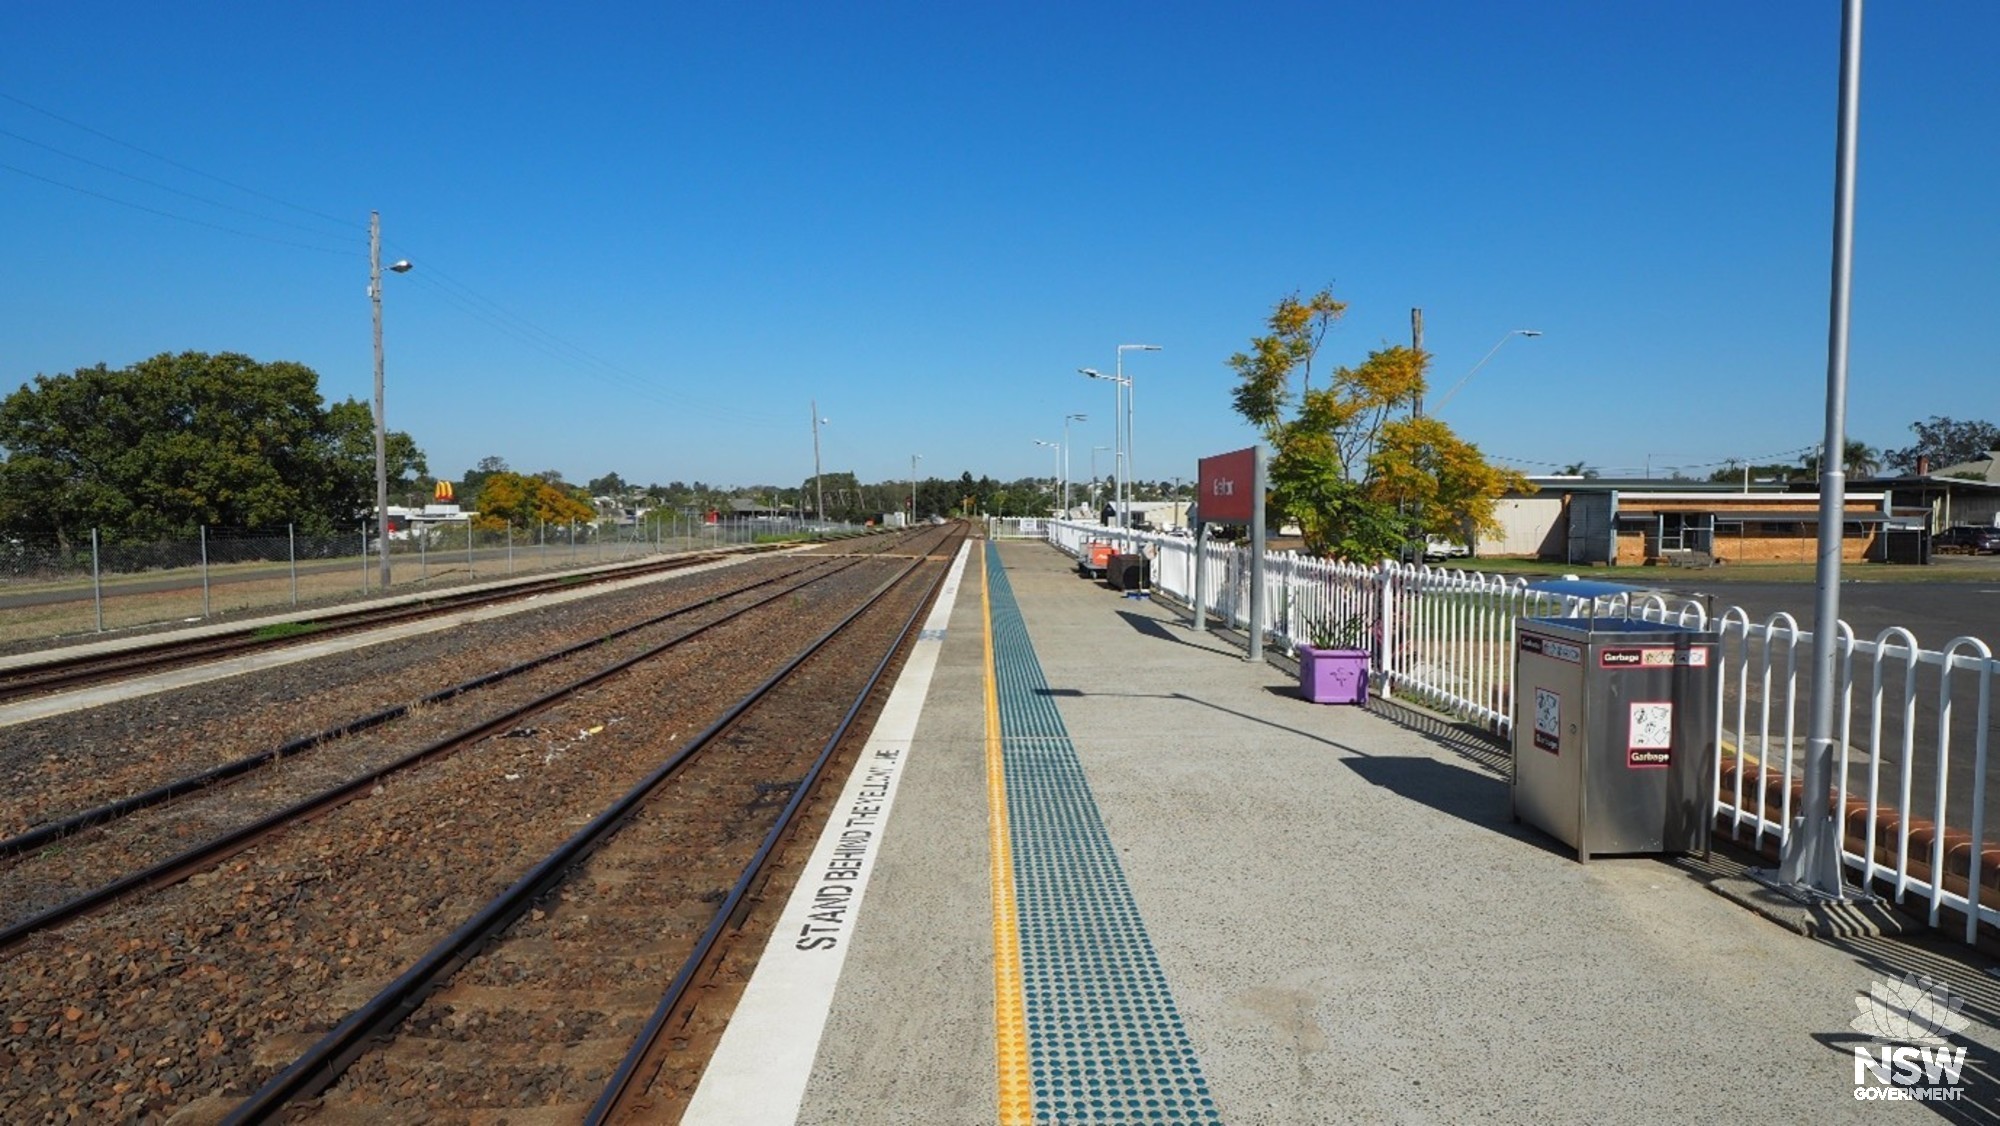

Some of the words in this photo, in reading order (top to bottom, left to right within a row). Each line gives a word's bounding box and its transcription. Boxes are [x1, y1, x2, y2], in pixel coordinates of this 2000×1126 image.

[1604, 653, 1640, 662] Garbage
[1631, 752, 1670, 762] Garbage
[845, 805, 880, 828] THE
[823, 829, 872, 881] BEHIND
[795, 885, 853, 950] STAND
